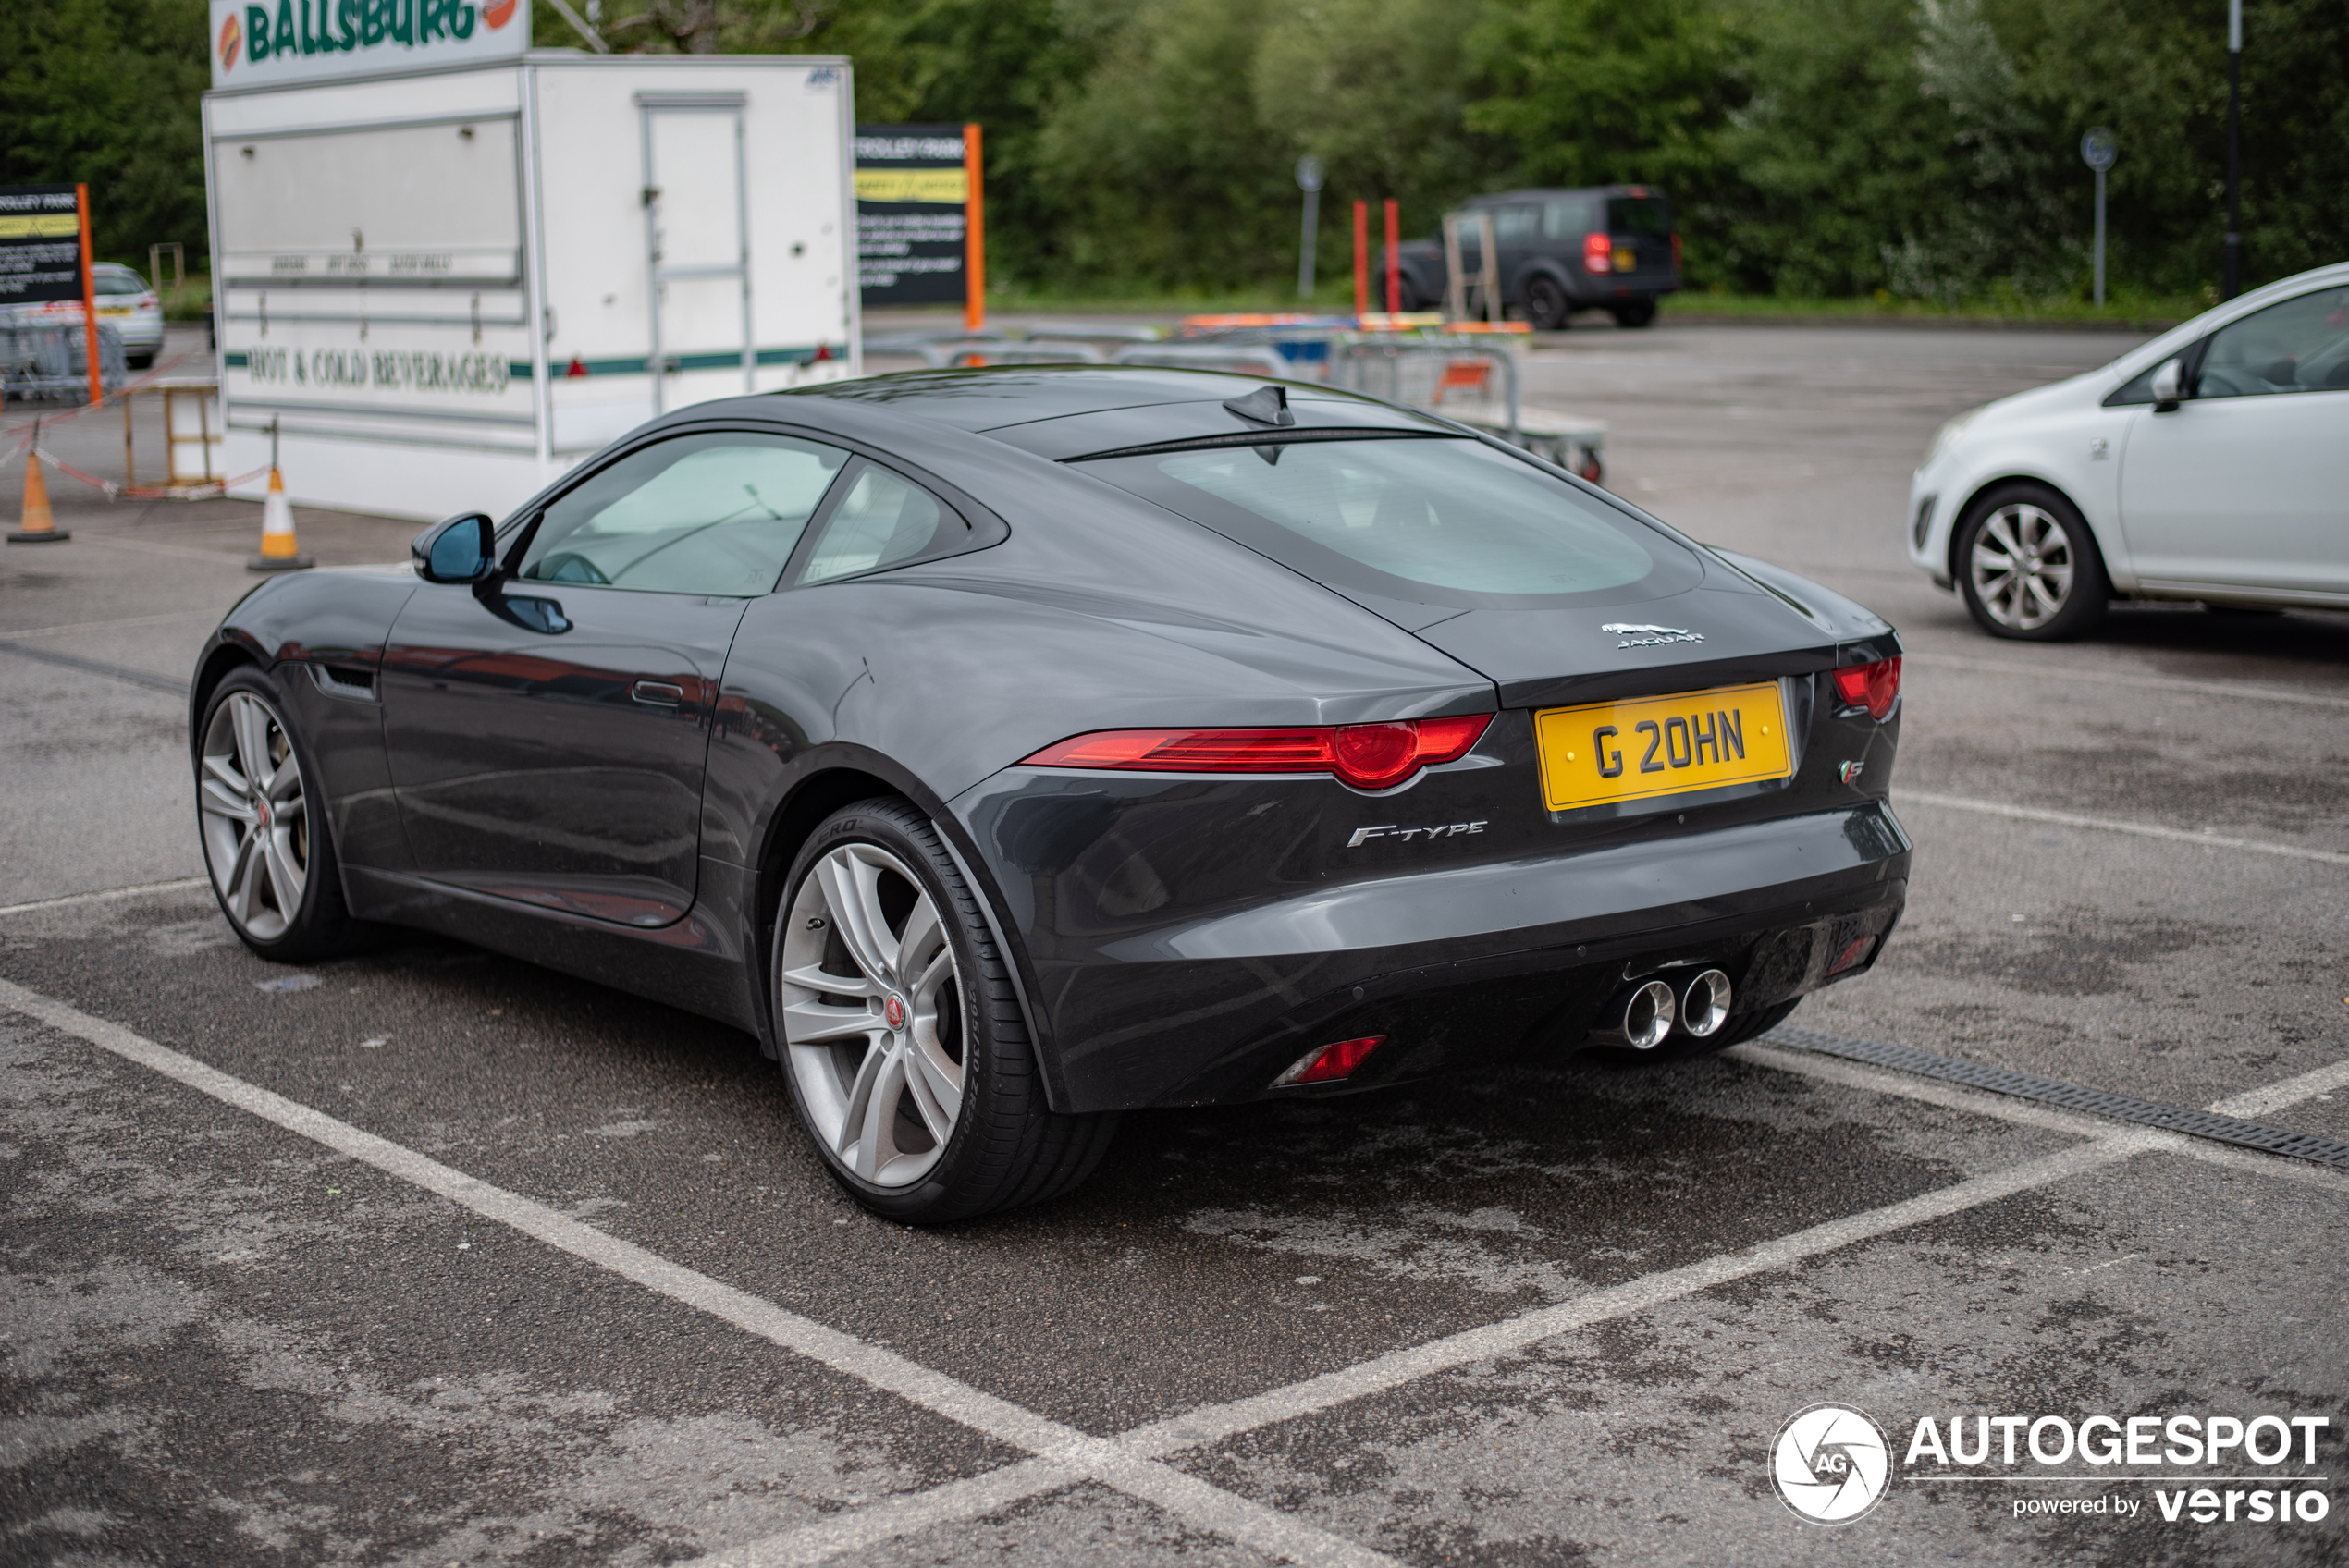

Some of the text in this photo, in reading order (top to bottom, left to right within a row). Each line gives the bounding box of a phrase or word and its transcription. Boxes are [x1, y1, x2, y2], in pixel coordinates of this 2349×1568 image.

[43, 192, 77, 209] PARK
[248, 347, 510, 393] HOT & COLD BEVERAGES
[1617, 633, 1705, 650] JAGUAR
[1593, 725, 1624, 779] G
[1347, 821, 1488, 848] F-TYPE
